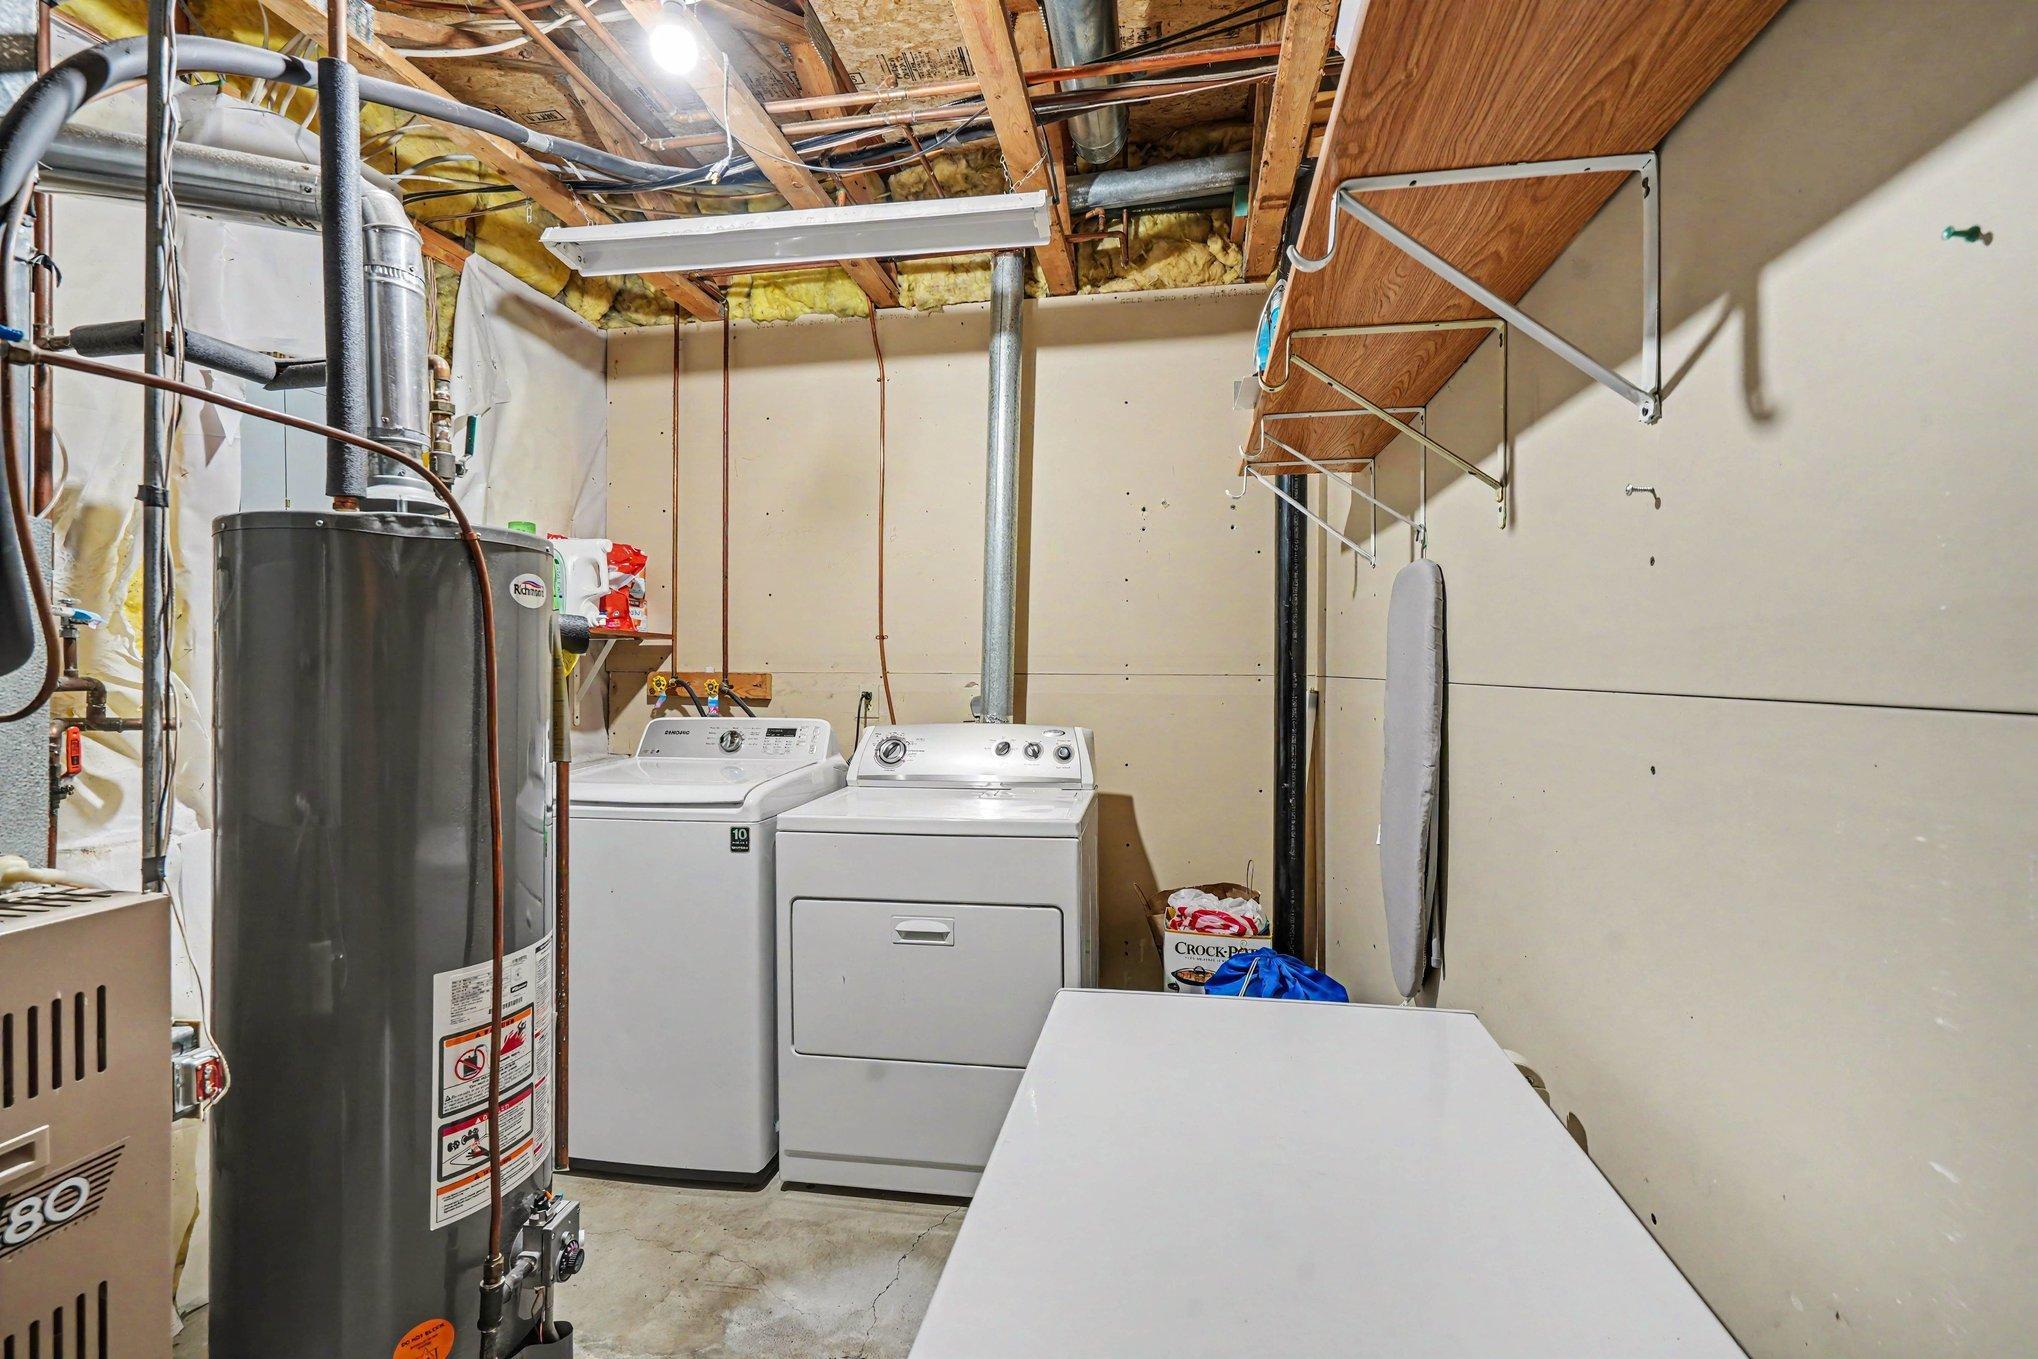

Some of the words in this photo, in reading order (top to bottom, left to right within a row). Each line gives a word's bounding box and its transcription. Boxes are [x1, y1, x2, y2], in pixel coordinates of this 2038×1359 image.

[732, 828, 748, 840] 10
[411, 1333, 423, 1342] NOT
[424, 1322, 445, 1336] BLOCK
